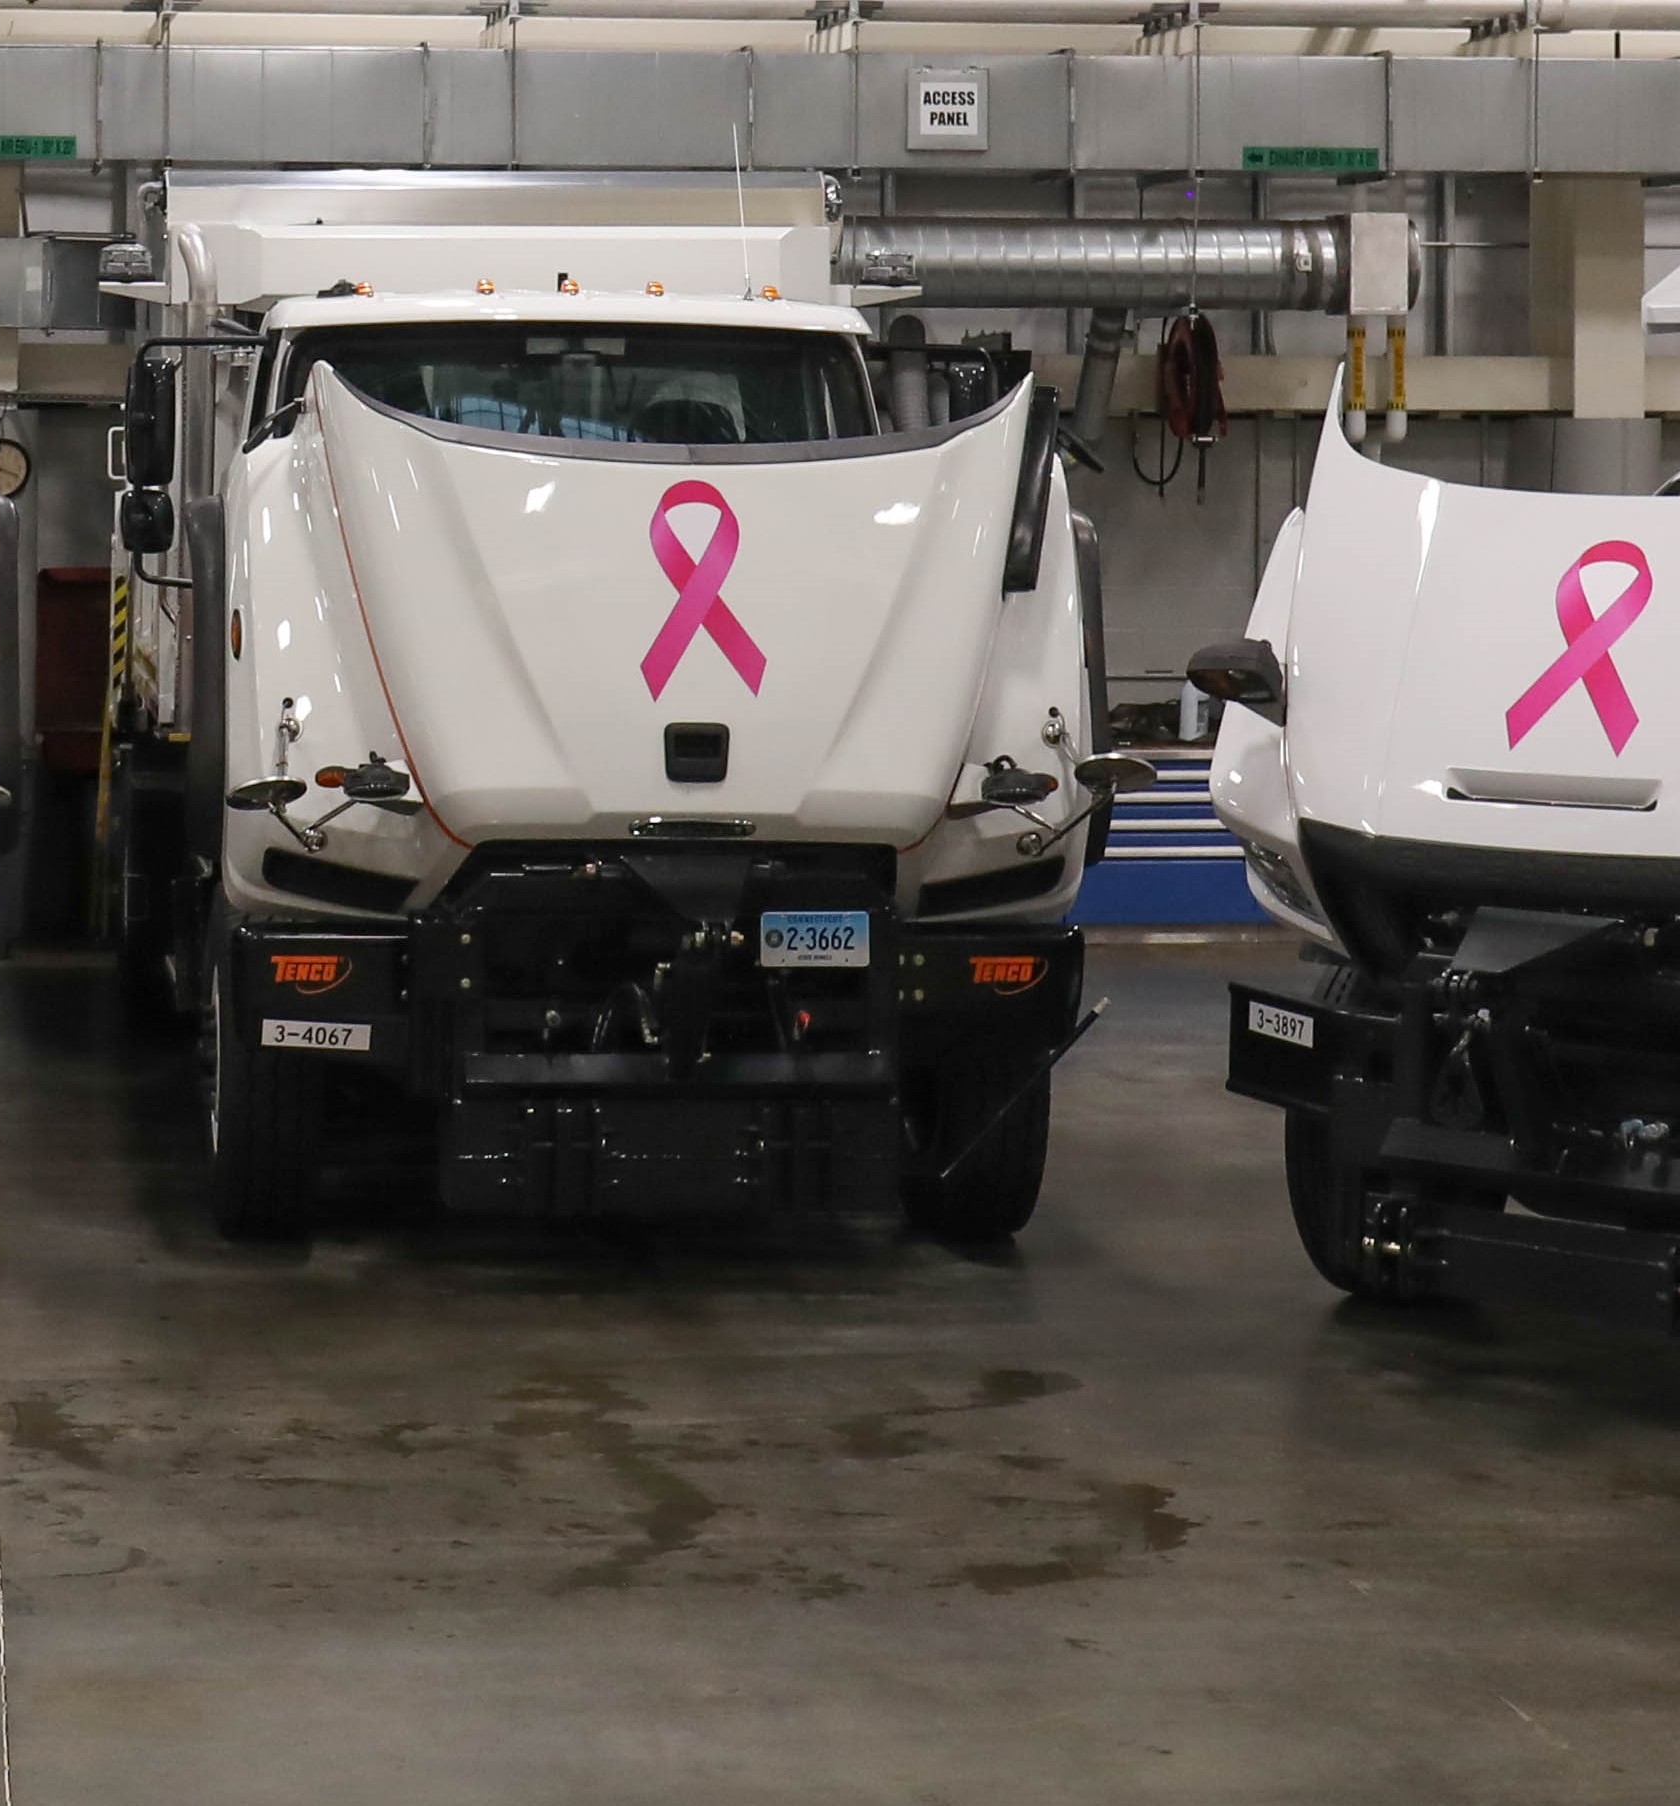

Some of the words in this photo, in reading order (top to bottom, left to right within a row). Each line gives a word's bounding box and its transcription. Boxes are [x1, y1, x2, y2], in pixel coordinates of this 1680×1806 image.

[923, 91, 975, 106] ACCESS
[929, 111, 969, 126] PANEL
[271, 955, 338, 983] TENCO
[969, 956, 1035, 984] TENCO
[273, 1024, 353, 1047] 3-4067
[1257, 1008, 1304, 1040] 3-3897
